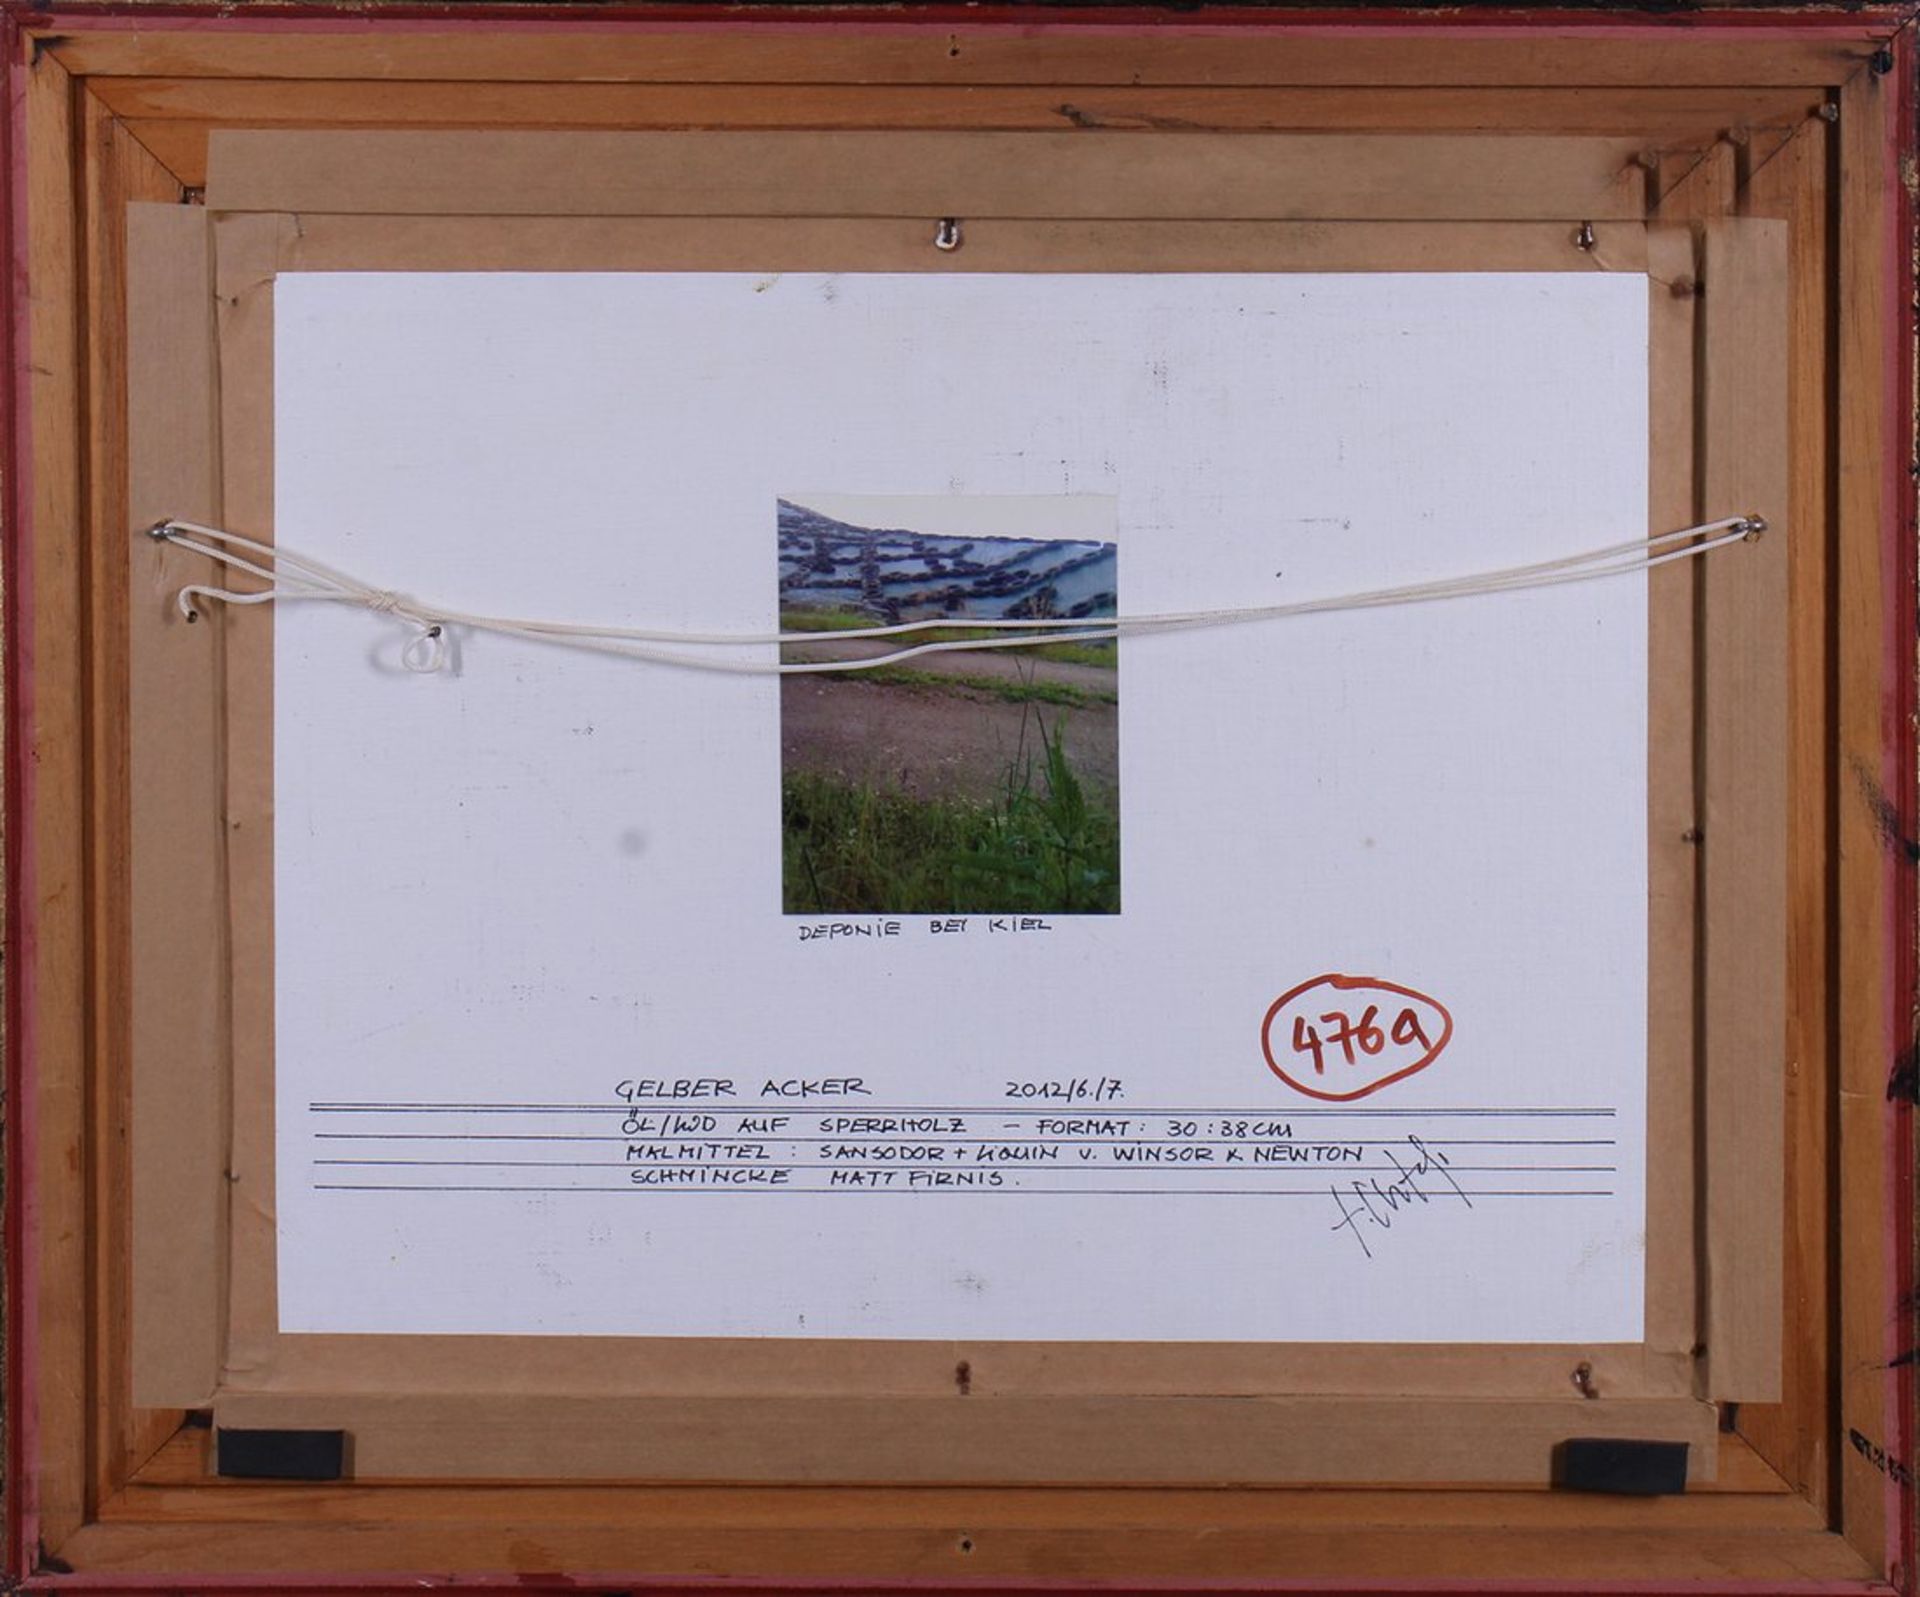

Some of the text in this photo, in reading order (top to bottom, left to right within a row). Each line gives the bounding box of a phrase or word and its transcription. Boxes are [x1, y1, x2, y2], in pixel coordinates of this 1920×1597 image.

[614, 1077, 872, 1103] GELBER ACKER
[736, 1116, 790, 1134] AUF
[819, 1117, 968, 1134] SPERRHOLZ
[819, 1144, 945, 1161] SANSODOR
[1253, 1145, 1364, 1163] NEWTON
[829, 1169, 898, 1187] MATT
